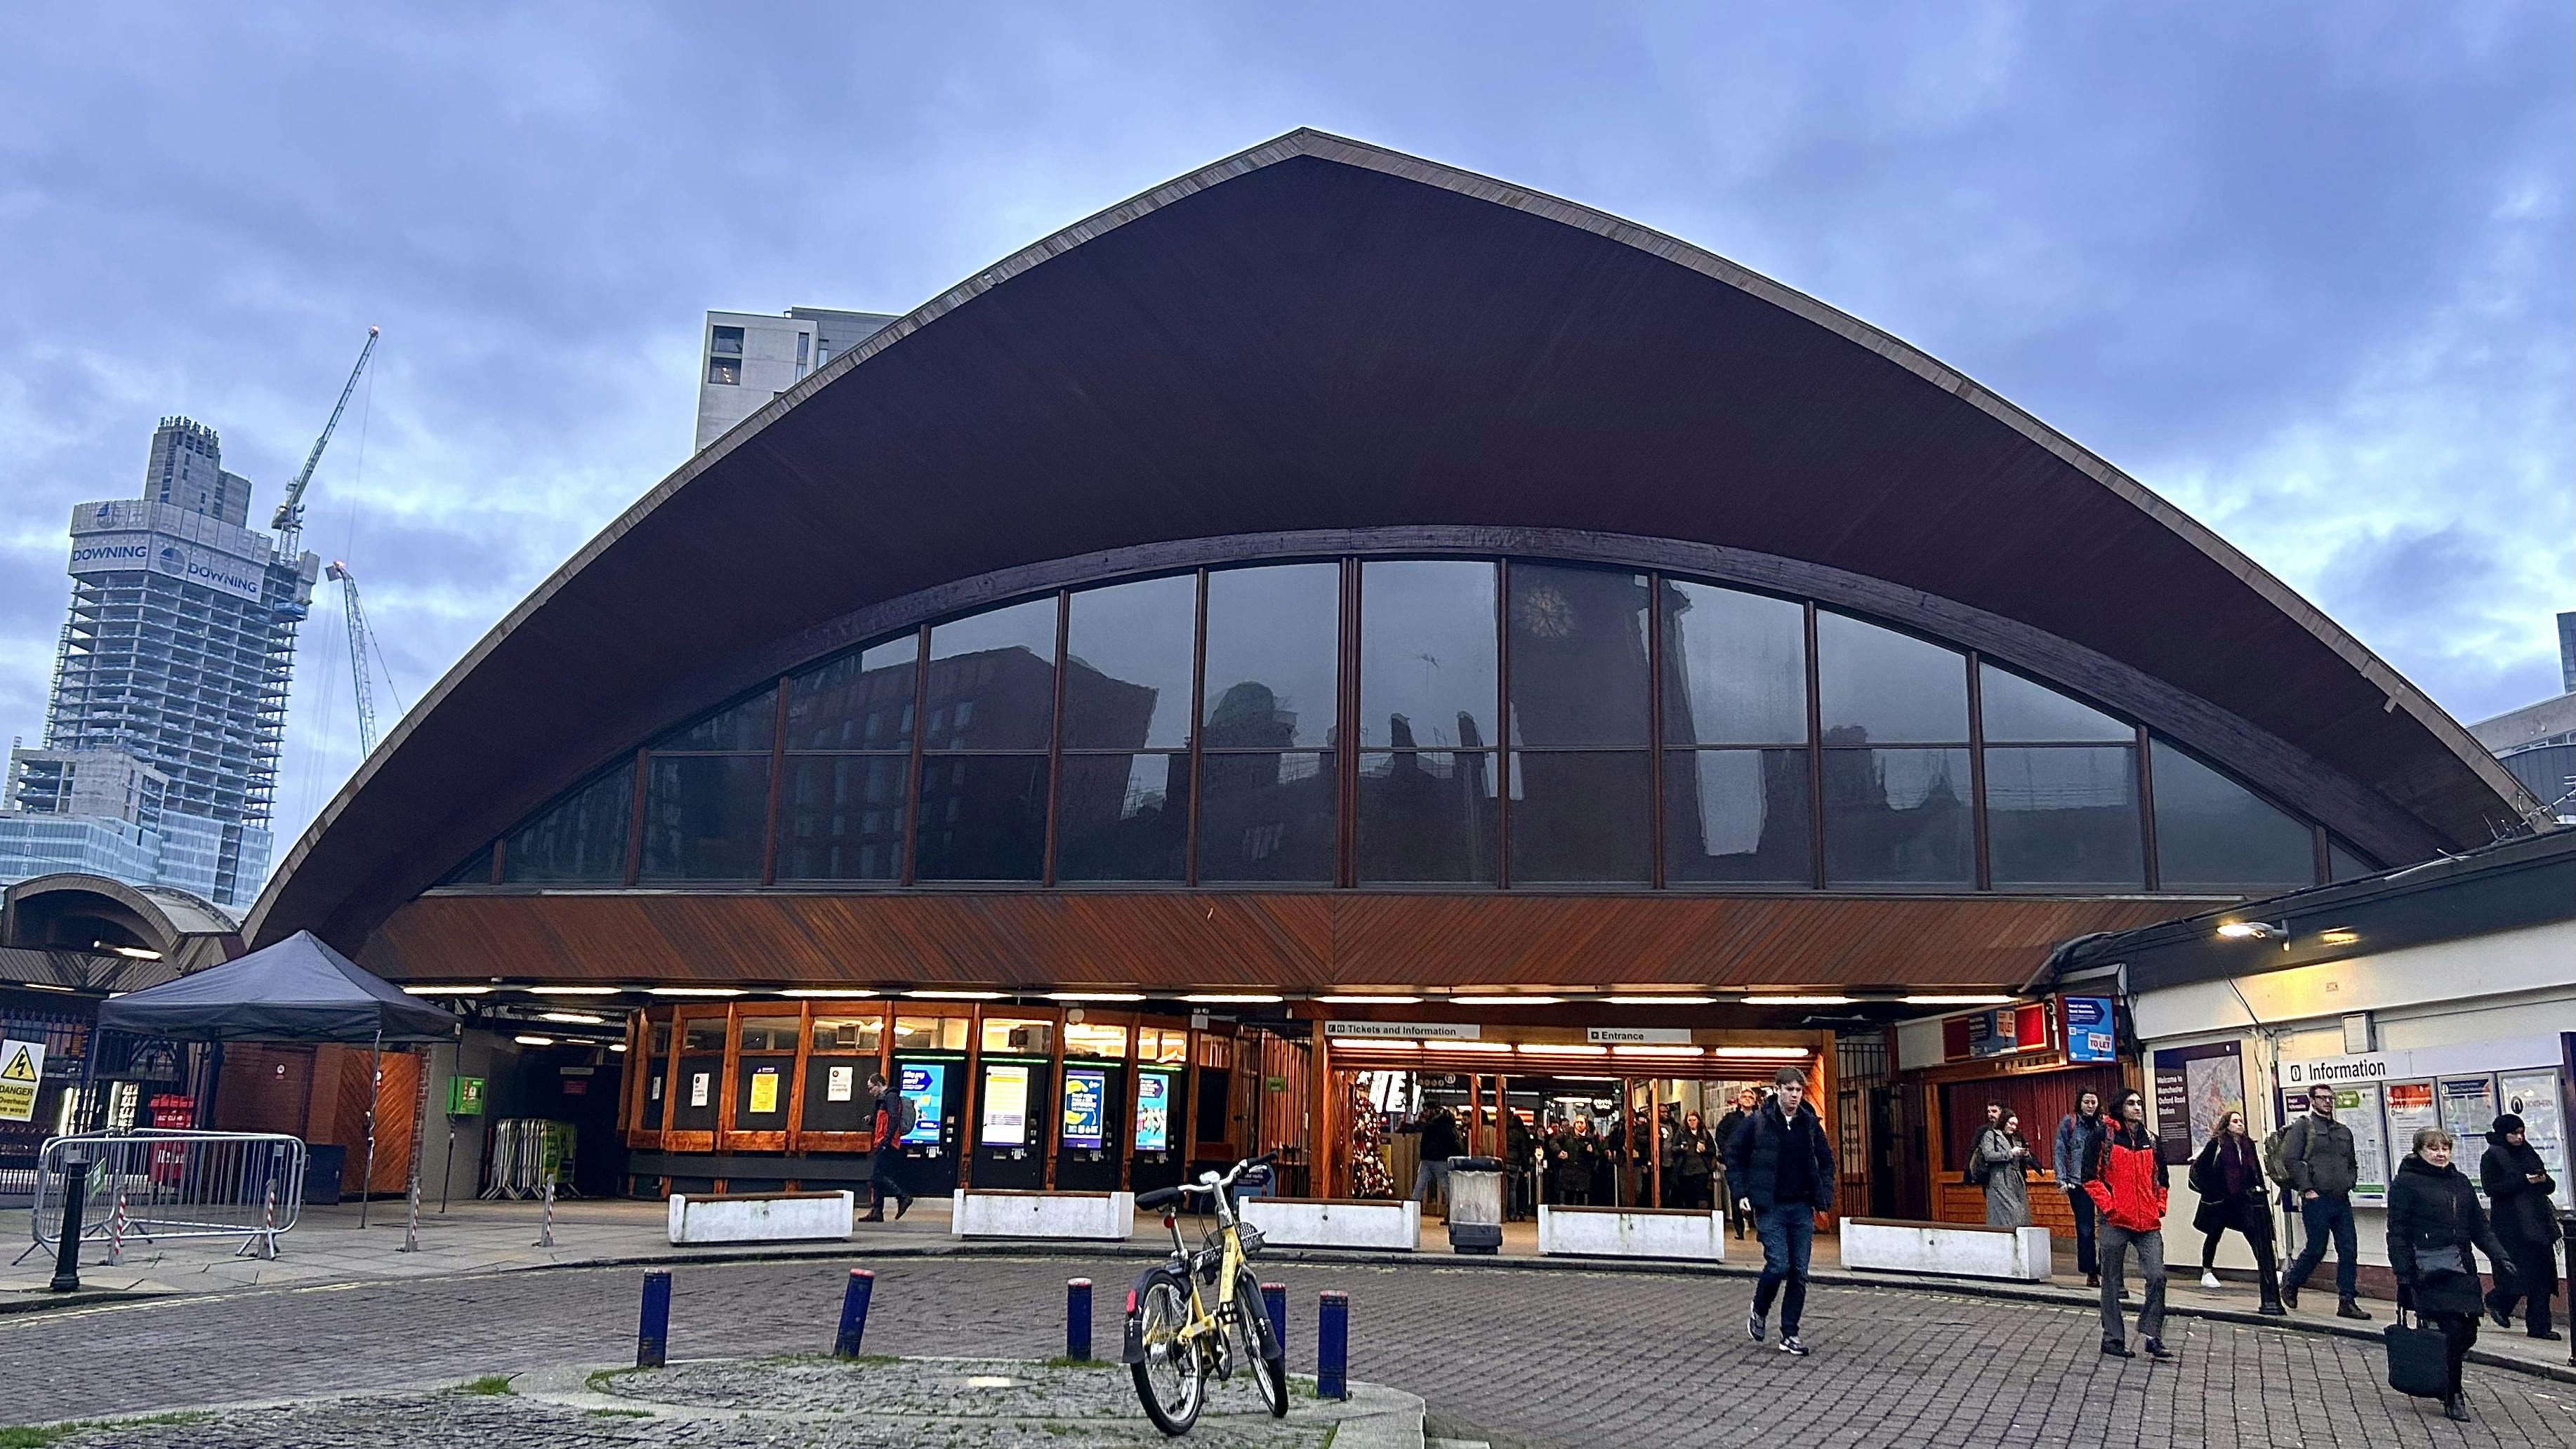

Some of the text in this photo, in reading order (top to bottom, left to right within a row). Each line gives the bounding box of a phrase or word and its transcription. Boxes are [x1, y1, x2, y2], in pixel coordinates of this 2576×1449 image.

[72, 546, 147, 562] DOWNING
[187, 562, 257, 593] DOWNING
[1347, 1025, 1456, 1036] Tickets and Information
[1601, 1031, 1644, 1040] Entrance
[2309, 1059, 2386, 1080] Information
[0, 1085, 34, 1096] DANGER
[2158, 1086, 2183, 1094] Manchester
[0, 1097, 30, 1106] Overhead
